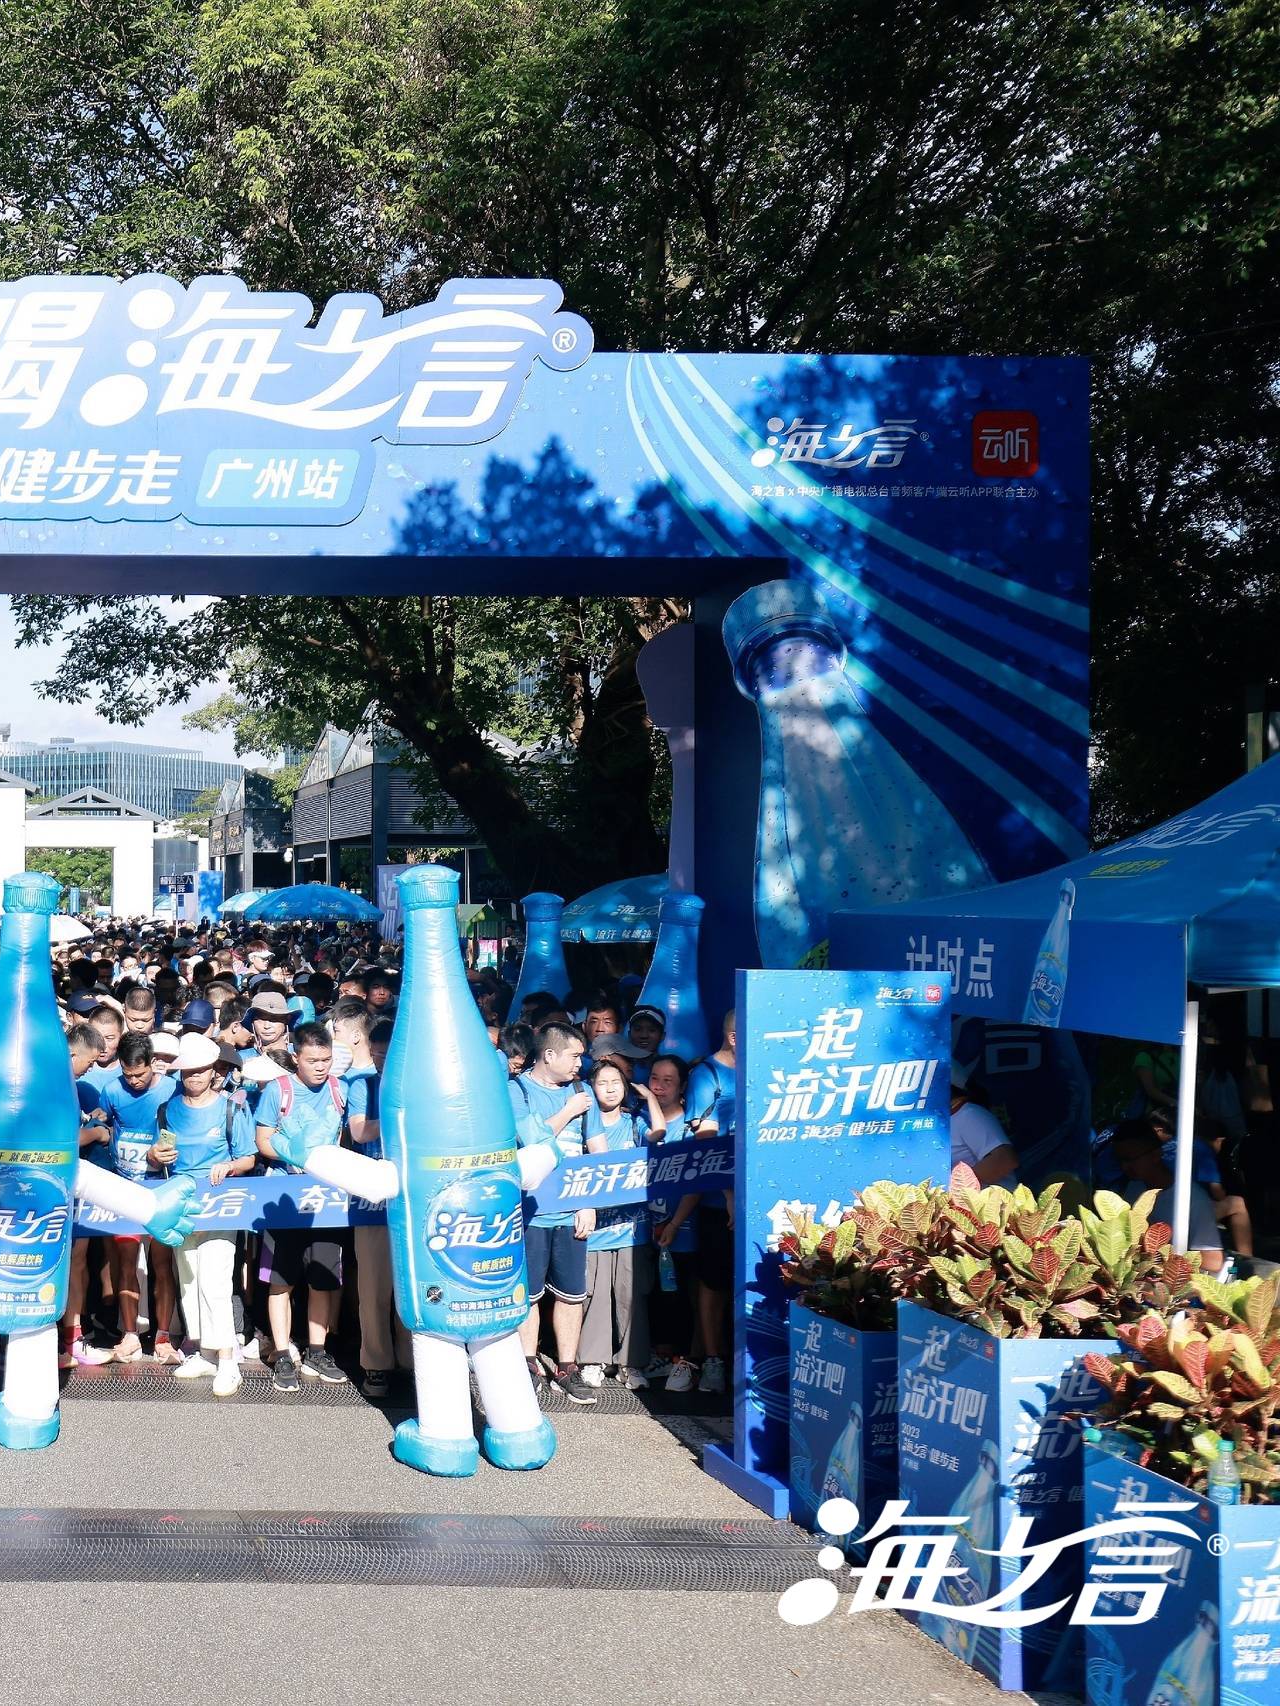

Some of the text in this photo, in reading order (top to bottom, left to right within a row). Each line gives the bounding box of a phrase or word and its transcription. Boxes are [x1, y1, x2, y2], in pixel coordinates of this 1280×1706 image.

[979, 427, 1030, 463] 云听
[205, 457, 344, 500] 广州站
[906, 934, 995, 1000] 计时点
[763, 1007, 863, 1063] 一起
[758, 1060, 939, 1124] 流汗吧!
[757, 1126, 797, 1143] 2023
[848, 1120, 895, 1138] 健步走
[901, 1117, 935, 1131] 广州站
[428, 1204, 522, 1251] 海之言
[793, 1320, 823, 1352] 一起
[902, 1325, 950, 1372] 一起
[792, 1350, 847, 1396] 流汗吧!
[900, 1368, 990, 1437] 流汗吧!
[902, 1422, 920, 1439] 2023
[929, 1447, 961, 1473] 健步走
